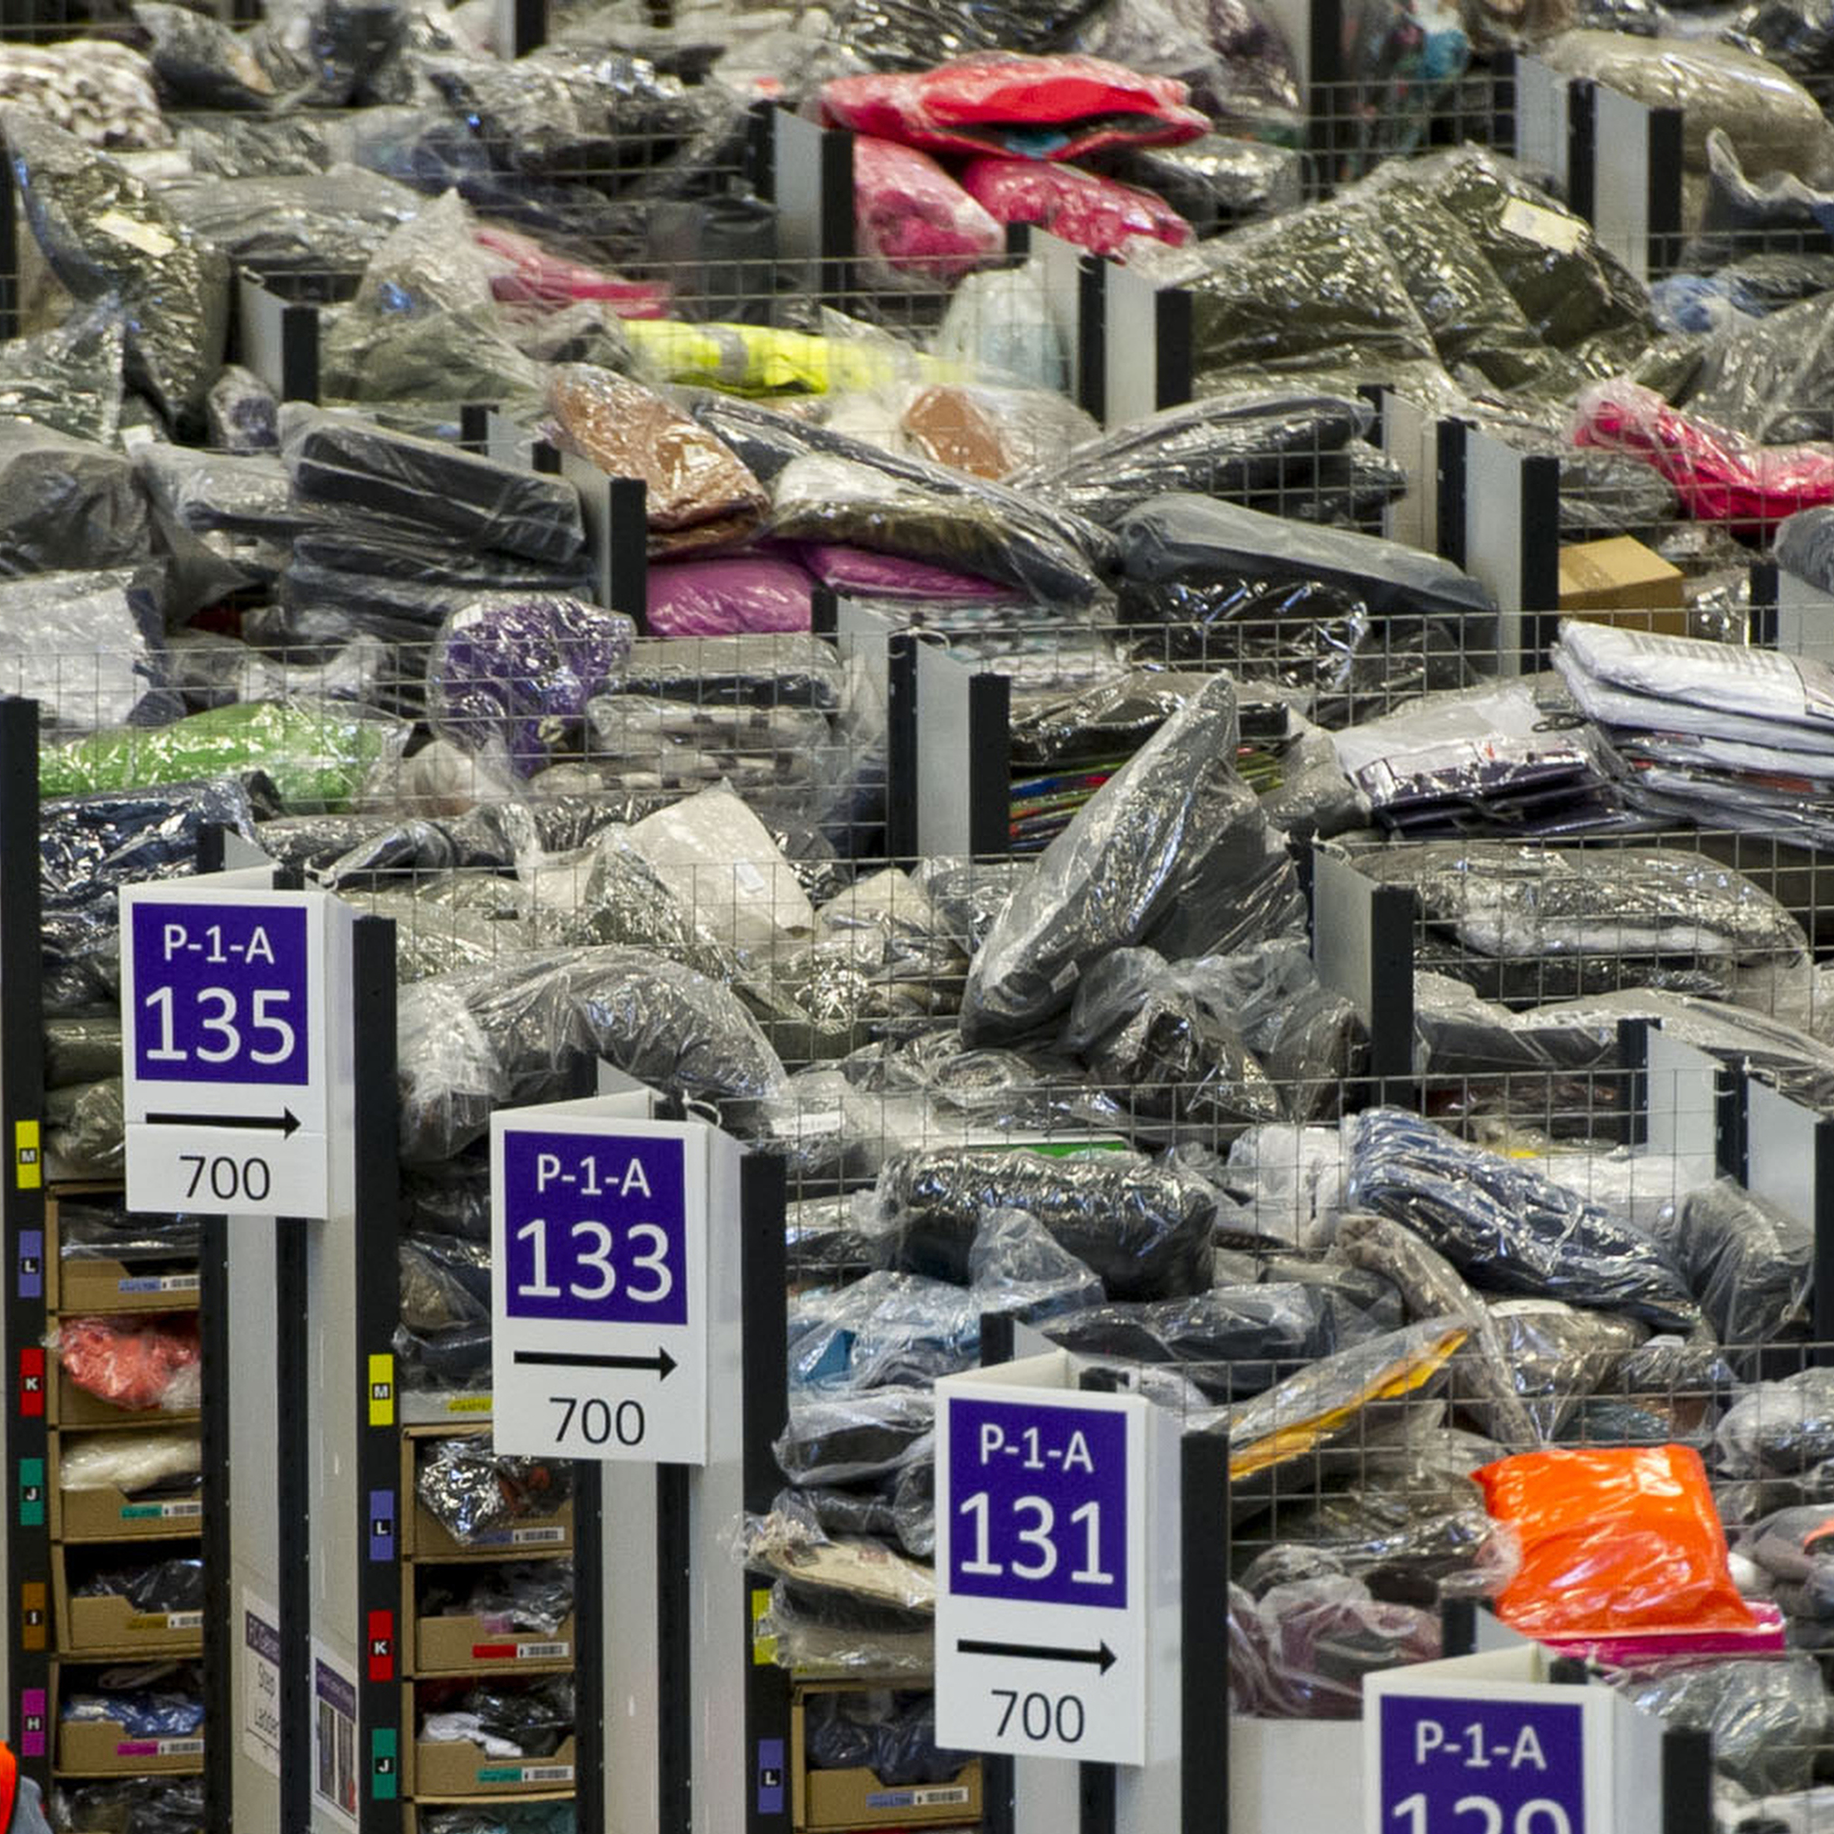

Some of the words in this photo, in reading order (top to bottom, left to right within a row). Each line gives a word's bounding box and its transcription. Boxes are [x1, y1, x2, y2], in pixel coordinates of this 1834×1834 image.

[165, 924, 274, 964] P-1-A
[146, 987, 294, 1064] 135
[22, 1150, 35, 1162] M
[180, 1156, 270, 1200] 700
[538, 1154, 650, 1197] P-1-A
[25, 1260, 35, 1273] L
[518, 1219, 672, 1302] 133
[26, 1378, 37, 1390] K
[374, 1385, 388, 1398] M
[550, 1398, 644, 1445] 700
[981, 1424, 1093, 1472] P-1-A
[26, 1488, 37, 1500] J
[377, 1522, 387, 1535] L
[961, 1492, 1113, 1584] 131
[375, 1642, 386, 1654] K
[28, 1718, 39, 1730] H
[992, 1690, 1084, 1743] 700
[1417, 1721, 1546, 1769] P-1-A
[379, 1759, 389, 1772] J
[765, 1771, 777, 1785] L
